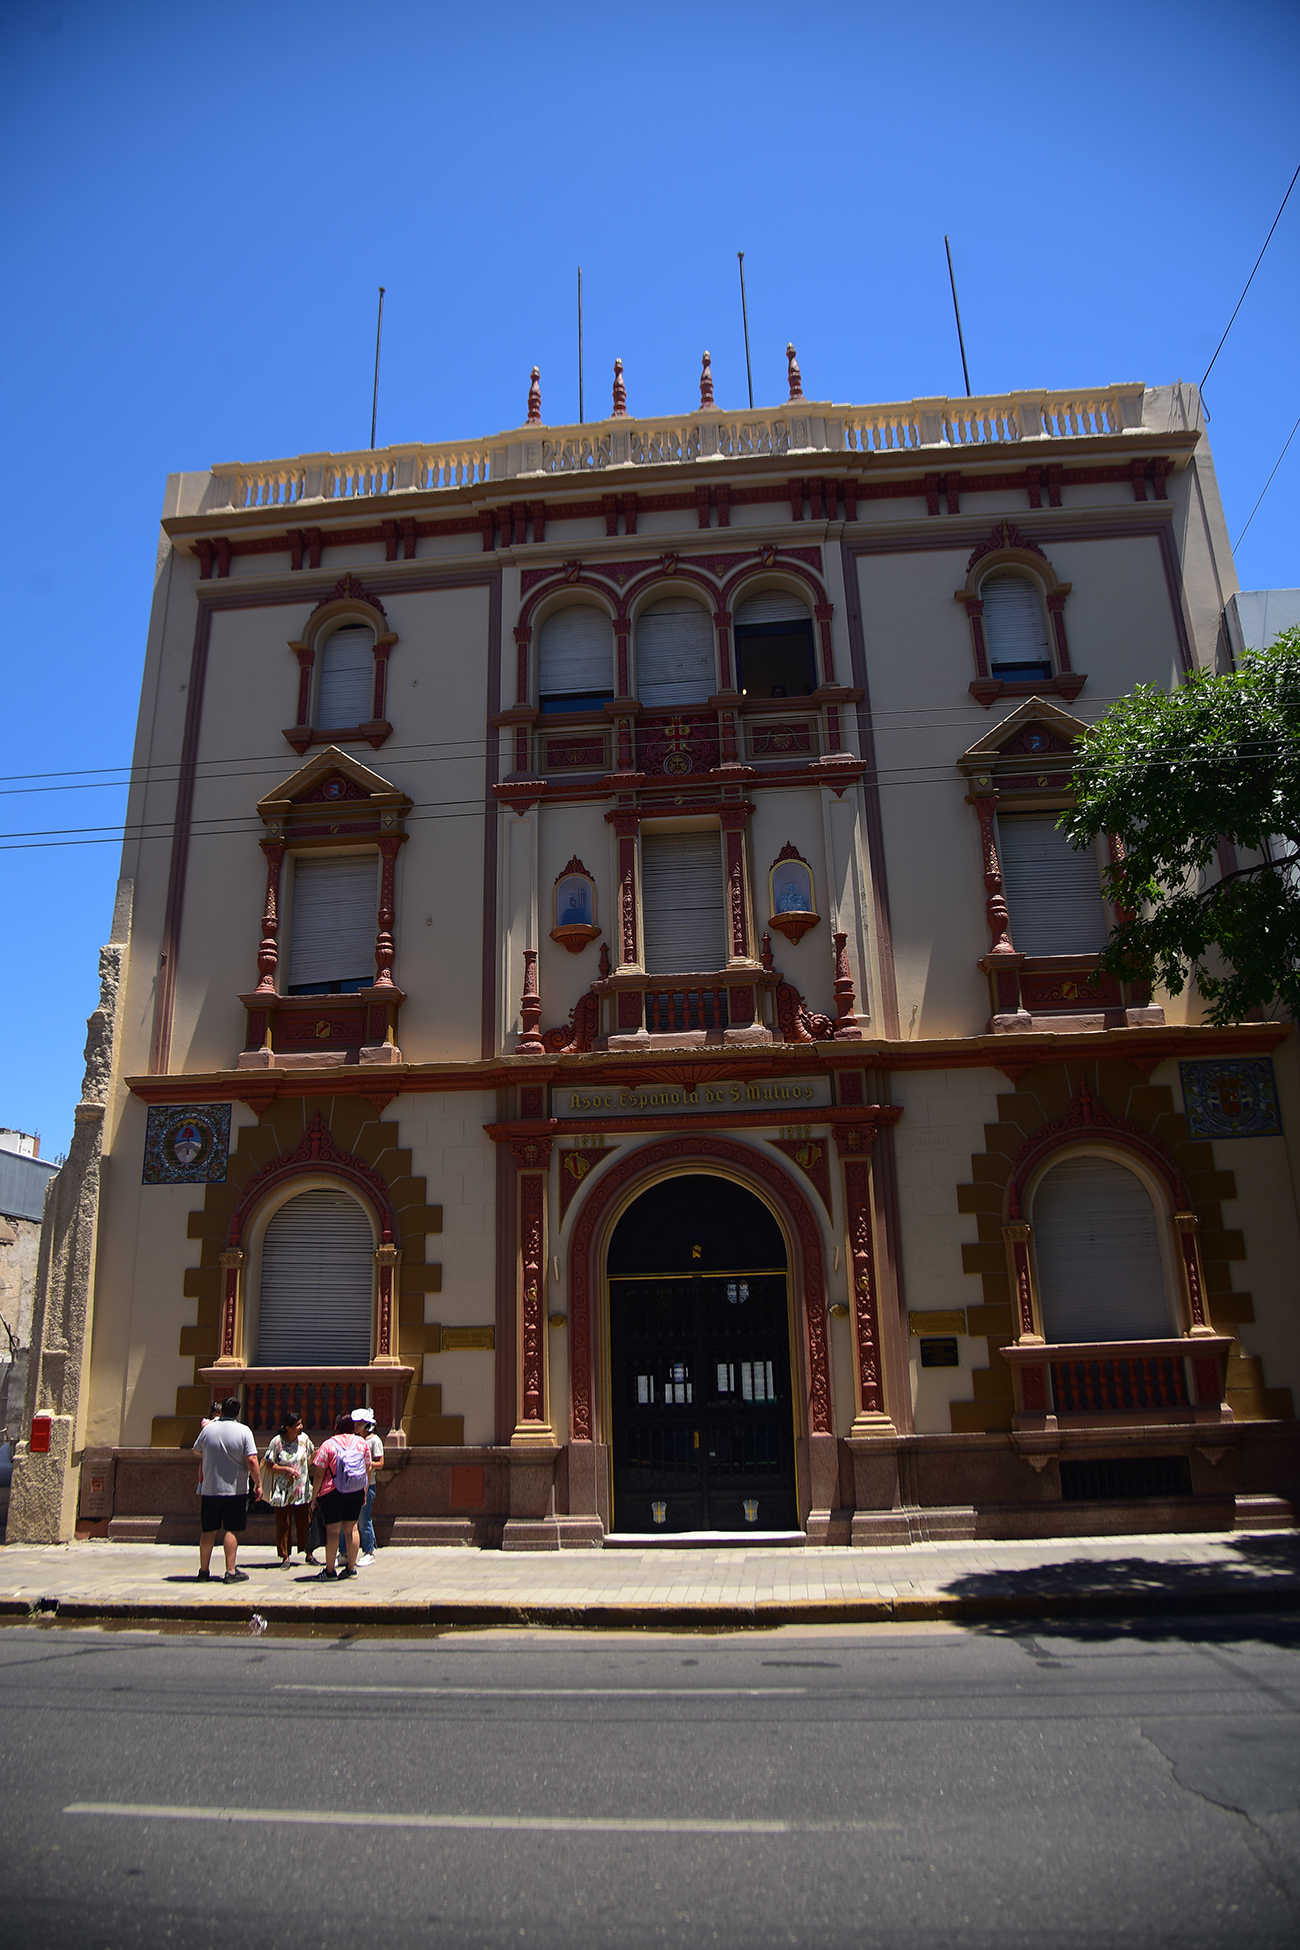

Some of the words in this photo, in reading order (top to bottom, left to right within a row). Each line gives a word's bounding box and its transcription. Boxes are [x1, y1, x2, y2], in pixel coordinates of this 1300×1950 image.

[568, 1092, 616, 1109] Asoc.
[619, 1088, 699, 1109] Española
[705, 1086, 724, 1103] de
[729, 1085, 744, 1102] S.
[746, 1084, 813, 1101] Mutuos
[574, 1134, 605, 1148] 1872
